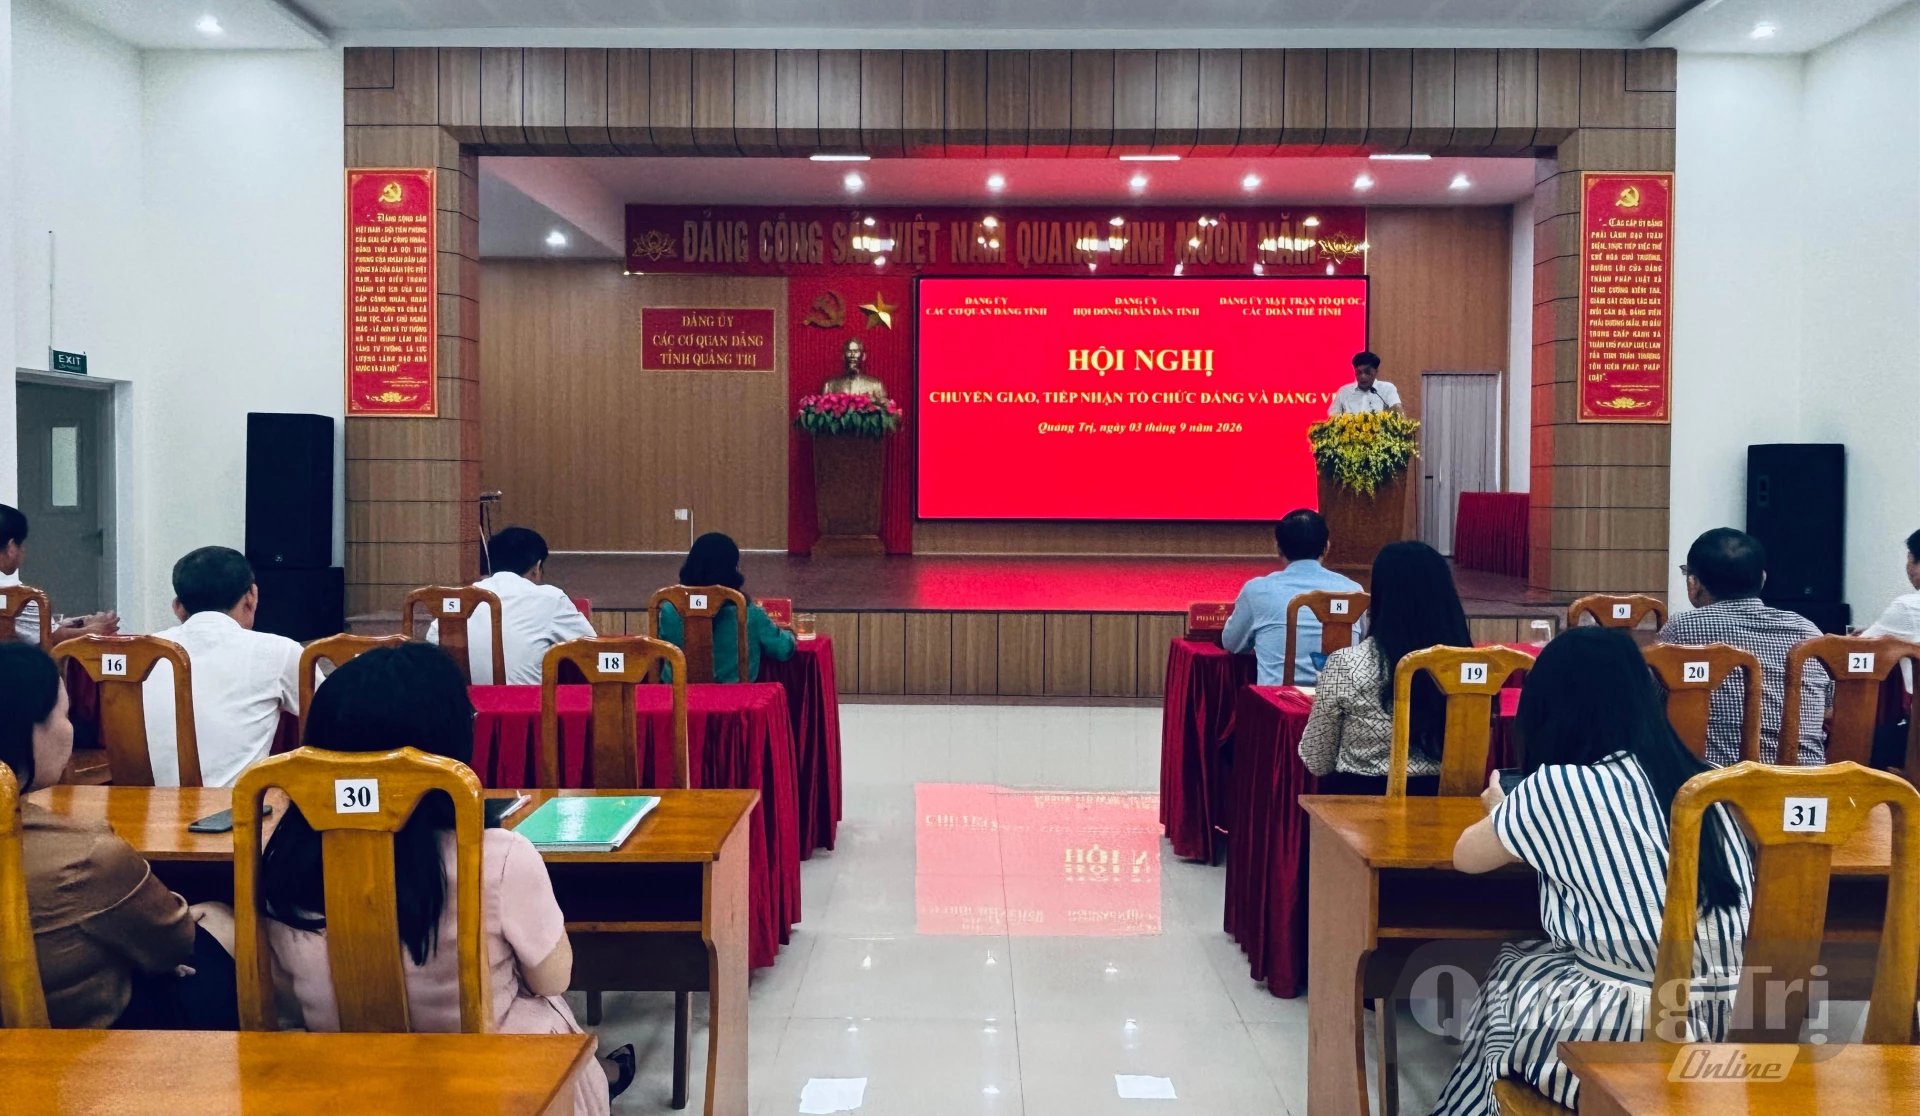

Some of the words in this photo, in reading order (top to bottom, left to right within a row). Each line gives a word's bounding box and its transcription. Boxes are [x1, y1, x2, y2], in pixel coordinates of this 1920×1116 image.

[683, 210, 749, 263] ĐẢNG
[951, 221, 1006, 264] NAM
[1016, 221, 1098, 267] QUANG
[1109, 221, 1164, 264] VINH
[1175, 212, 1246, 264] MUÔN
[1257, 212, 1316, 264] NĂM
[682, 311, 714, 327] ĐẢNG
[718, 312, 733, 327] ỦY
[653, 331, 674, 346] CÁC
[678, 334, 693, 346] CƠ
[696, 335, 727, 348] QUAN
[732, 331, 763, 346] ĐẢNG
[59, 355, 81, 365] EXIT
[660, 349, 689, 364] TỈNH
[693, 349, 732, 366] QUẢNG
[736, 354, 756, 367] TRỊ
[1068, 346, 1124, 376] HỘI
[1134, 349, 1214, 377] NGHỊ
[997, 392, 1040, 404] GIAO,
[1081, 391, 1123, 406] NHẬN
[1152, 390, 1196, 403] CHỨC
[1201, 391, 1244, 404] ĐẢNG
[1248, 390, 1269, 404] VÀ
[1273, 391, 1316, 404] ĐẢNG
[1100, 423, 1126, 434] ngày
[1129, 422, 1142, 432] 03
[1145, 422, 1176, 434] tháng
[1180, 422, 1186, 432] 9
[1189, 423, 1212, 432] năm
[1216, 423, 1242, 432] 2026
[1336, 603, 1342, 611] 8
[1619, 607, 1624, 616] 9
[108, 659, 122, 671] 16
[605, 657, 619, 669] 18
[1854, 657, 1867, 669] 21
[1467, 668, 1482, 680] 19
[1689, 667, 1704, 678] 20
[343, 787, 371, 807] 30
[1790, 806, 1816, 826] 31
